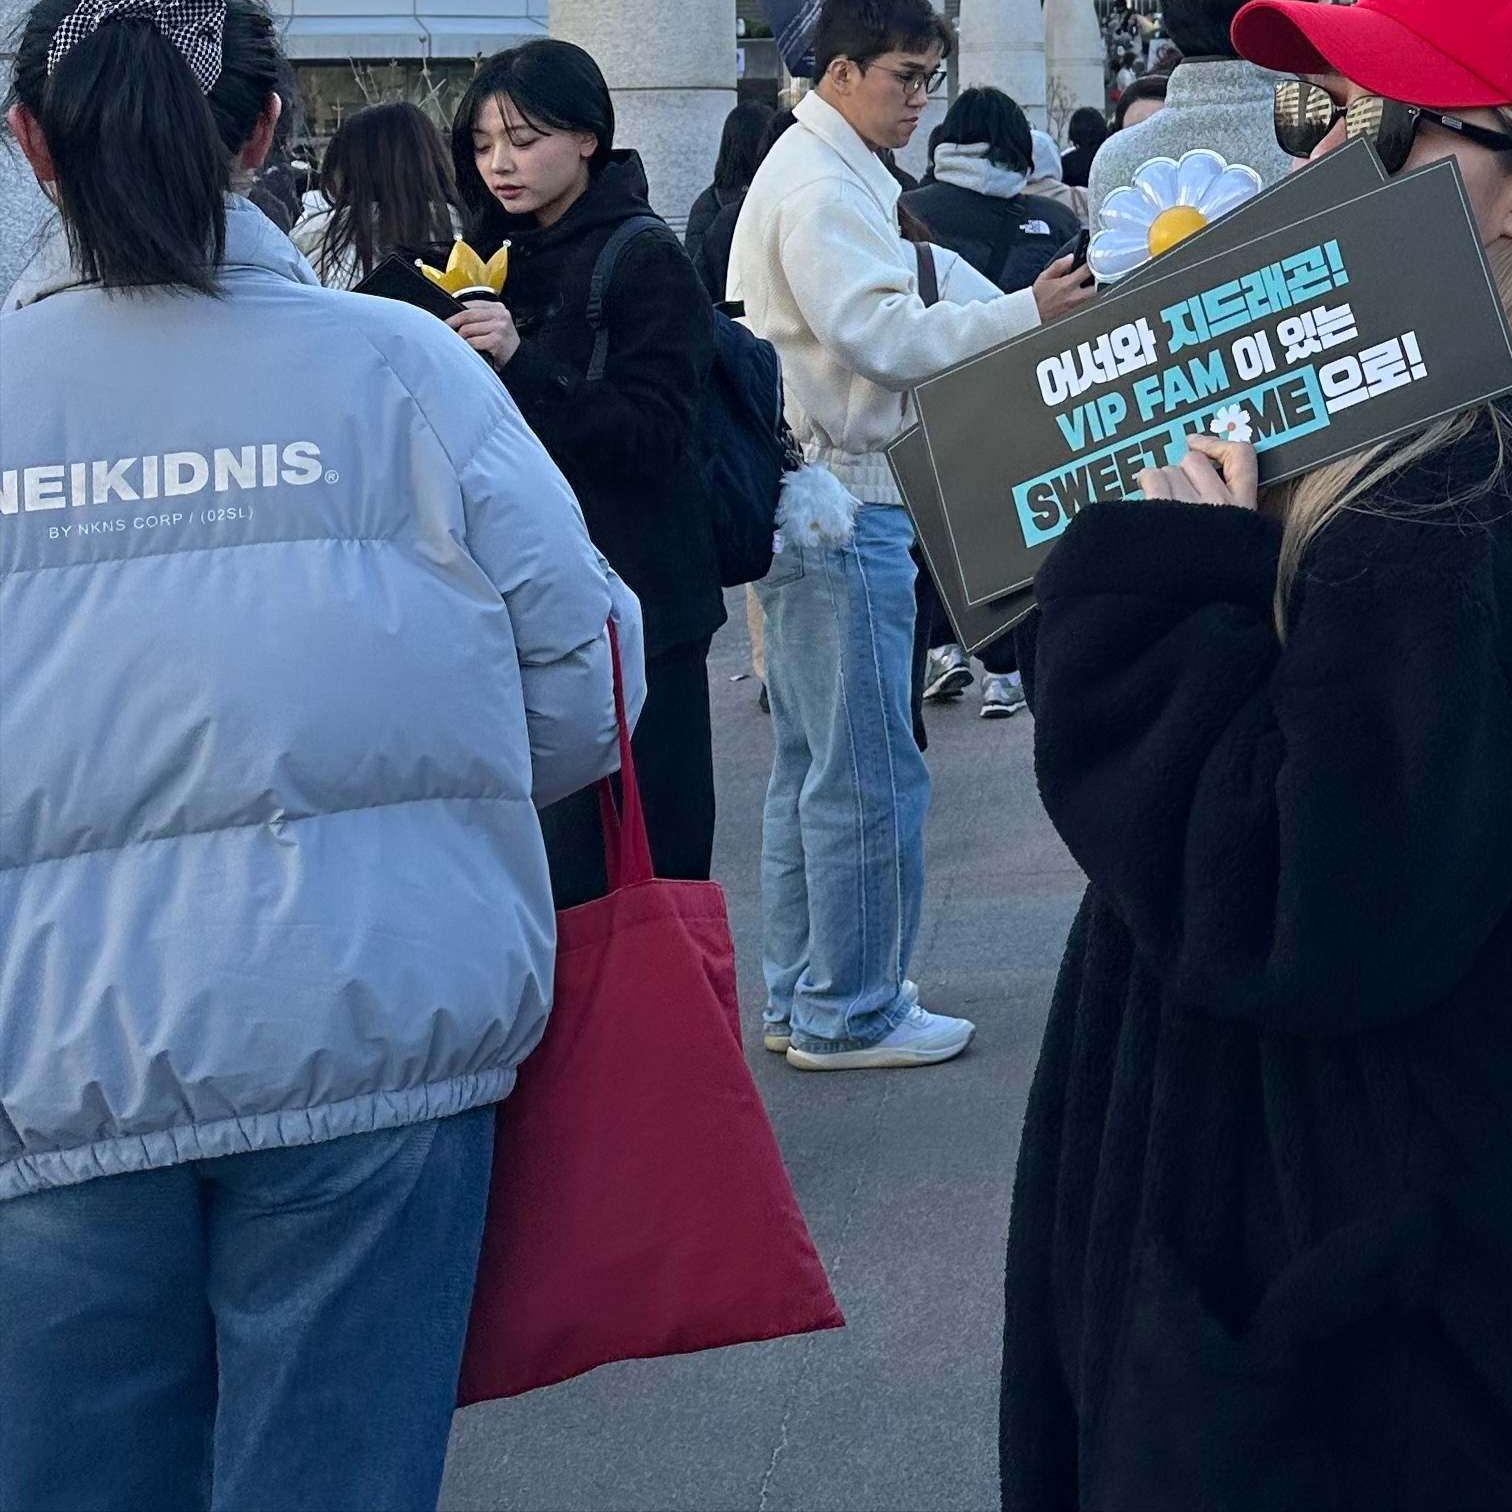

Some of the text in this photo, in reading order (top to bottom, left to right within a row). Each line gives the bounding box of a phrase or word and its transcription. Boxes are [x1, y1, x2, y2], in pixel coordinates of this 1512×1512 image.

[1035, 239, 1349, 407] 어서와 지드래곤!
[1056, 391, 1128, 452] VIP
[1133, 350, 1230, 423] FAM
[1276, 303, 1360, 365] 있는
[49, 525, 72, 539] BY
[78, 519, 126, 537] NKNS
[133, 513, 183, 529] CORP
